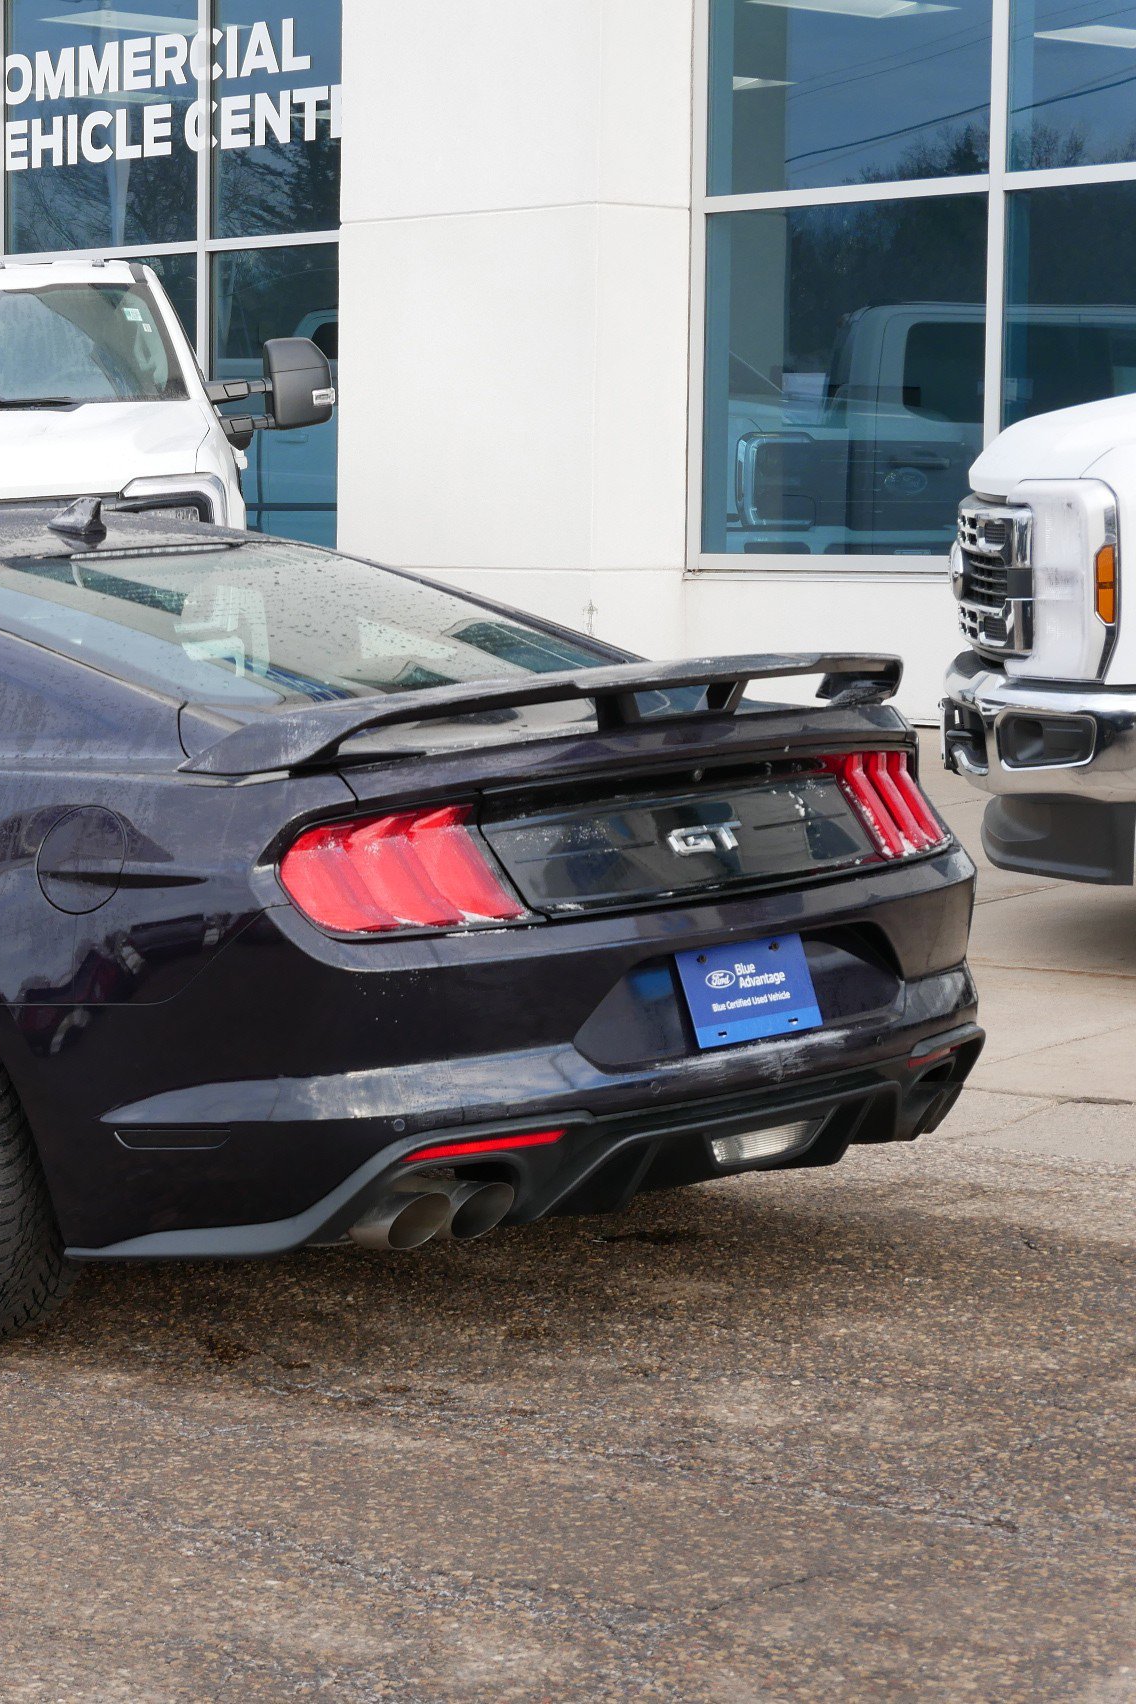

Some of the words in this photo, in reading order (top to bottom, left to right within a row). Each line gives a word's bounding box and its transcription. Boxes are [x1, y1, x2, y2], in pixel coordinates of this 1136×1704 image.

[667, 820, 742, 857] GT
[734, 962, 756, 976] Blue
[711, 972, 731, 986] Ford
[739, 971, 786, 989] Advantage
[711, 1002, 727, 1013] Blue
[726, 997, 752, 1010] Certified
[751, 994, 769, 1005] Used
[767, 990, 791, 1002] Vehicle
